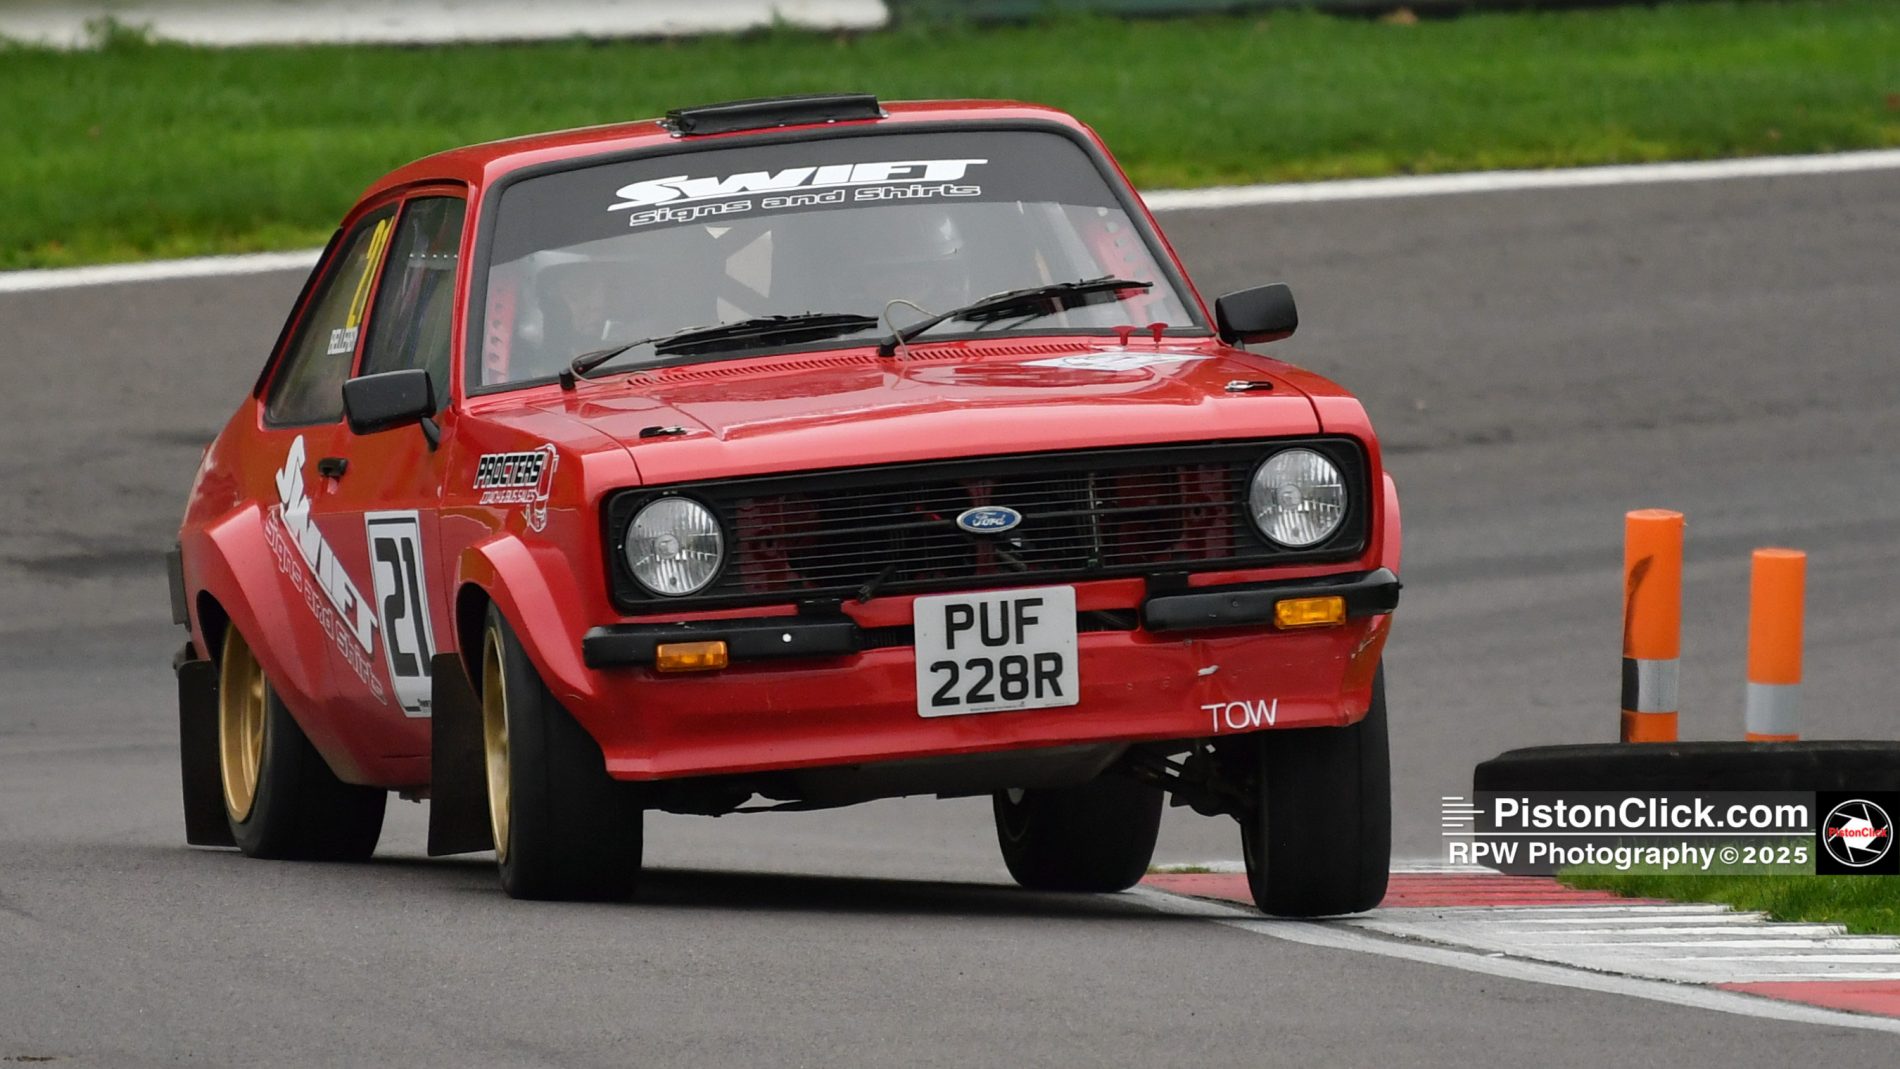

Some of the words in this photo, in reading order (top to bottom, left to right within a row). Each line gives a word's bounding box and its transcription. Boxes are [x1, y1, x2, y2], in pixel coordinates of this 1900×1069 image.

[607, 158, 988, 210] SWIFT
[629, 200, 751, 227] Signs
[761, 189, 846, 209] and
[854, 182, 981, 203] Shirts
[473, 451, 547, 489] PROCTERS
[275, 434, 378, 655] SWIFT
[972, 511, 1007, 527] Ford
[373, 536, 434, 678] 21
[944, 597, 1044, 650] PUF
[929, 652, 1064, 707] 228R
[1200, 698, 1278, 733] TOW
